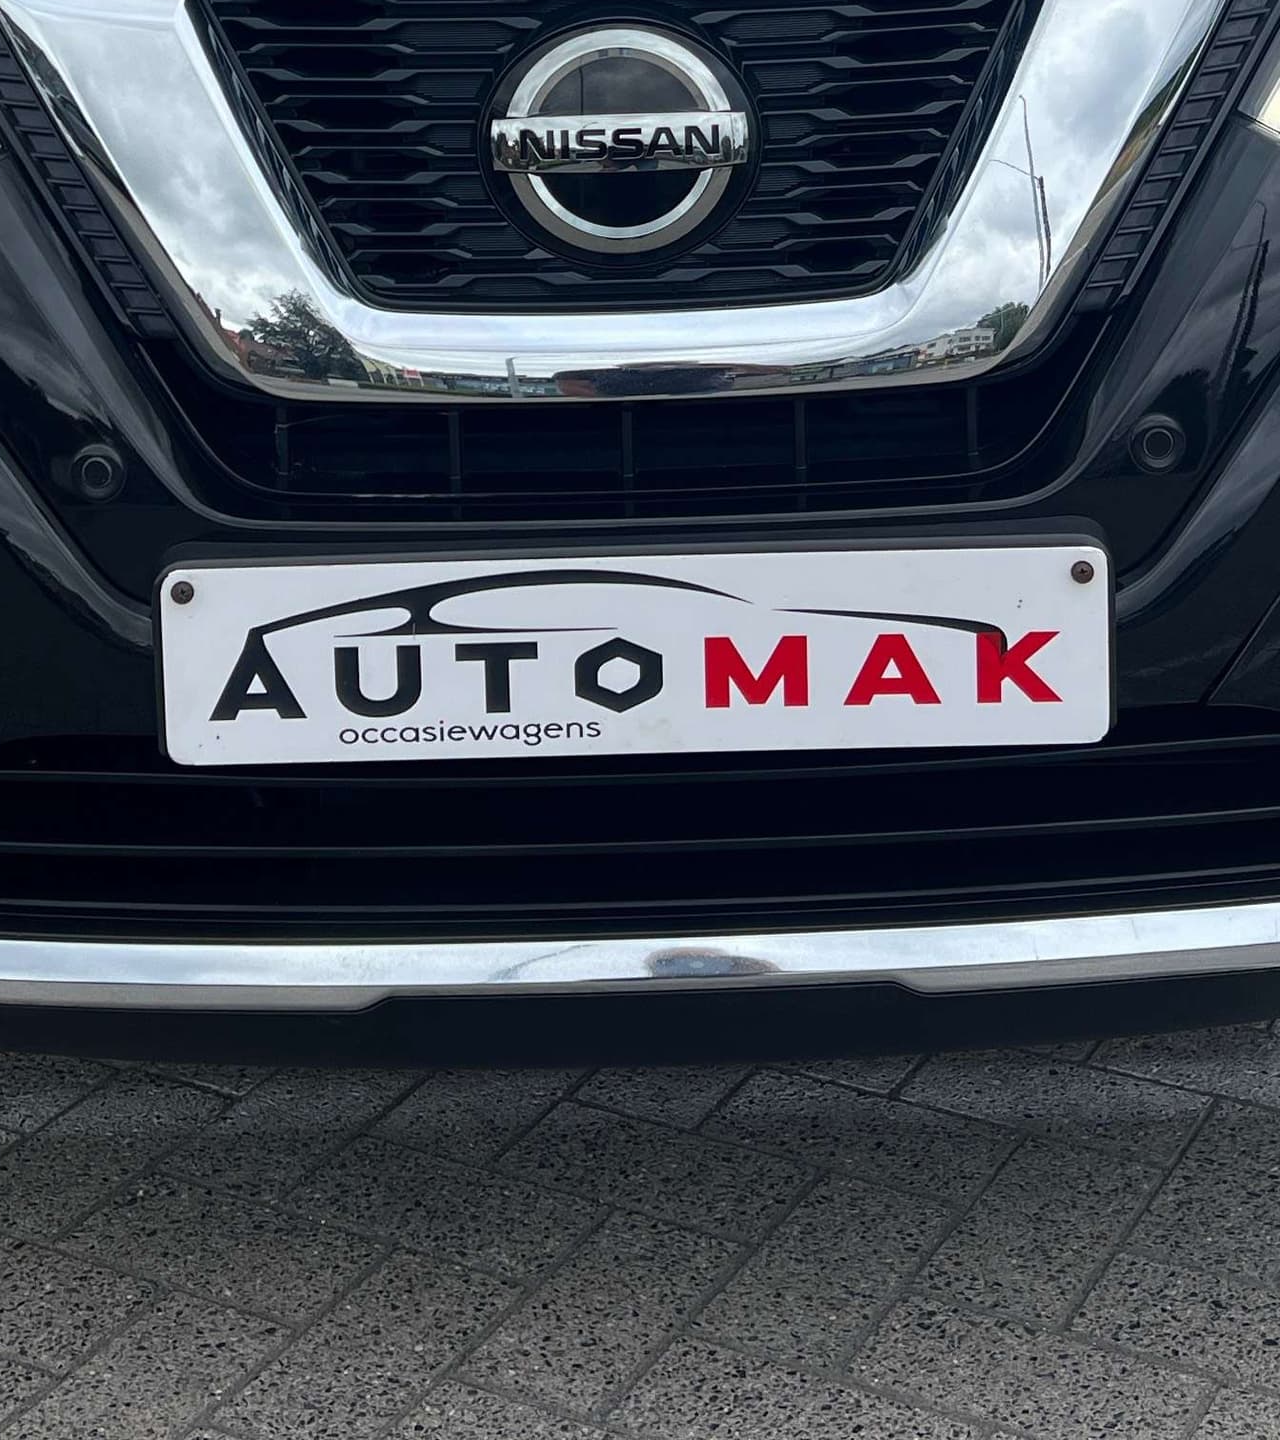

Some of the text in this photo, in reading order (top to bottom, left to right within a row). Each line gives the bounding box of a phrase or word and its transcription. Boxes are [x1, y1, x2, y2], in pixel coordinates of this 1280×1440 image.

[519, 123, 721, 161] NISSAN
[208, 629, 1062, 723] AUTOMAK
[338, 716, 602, 747] occasiewagens
